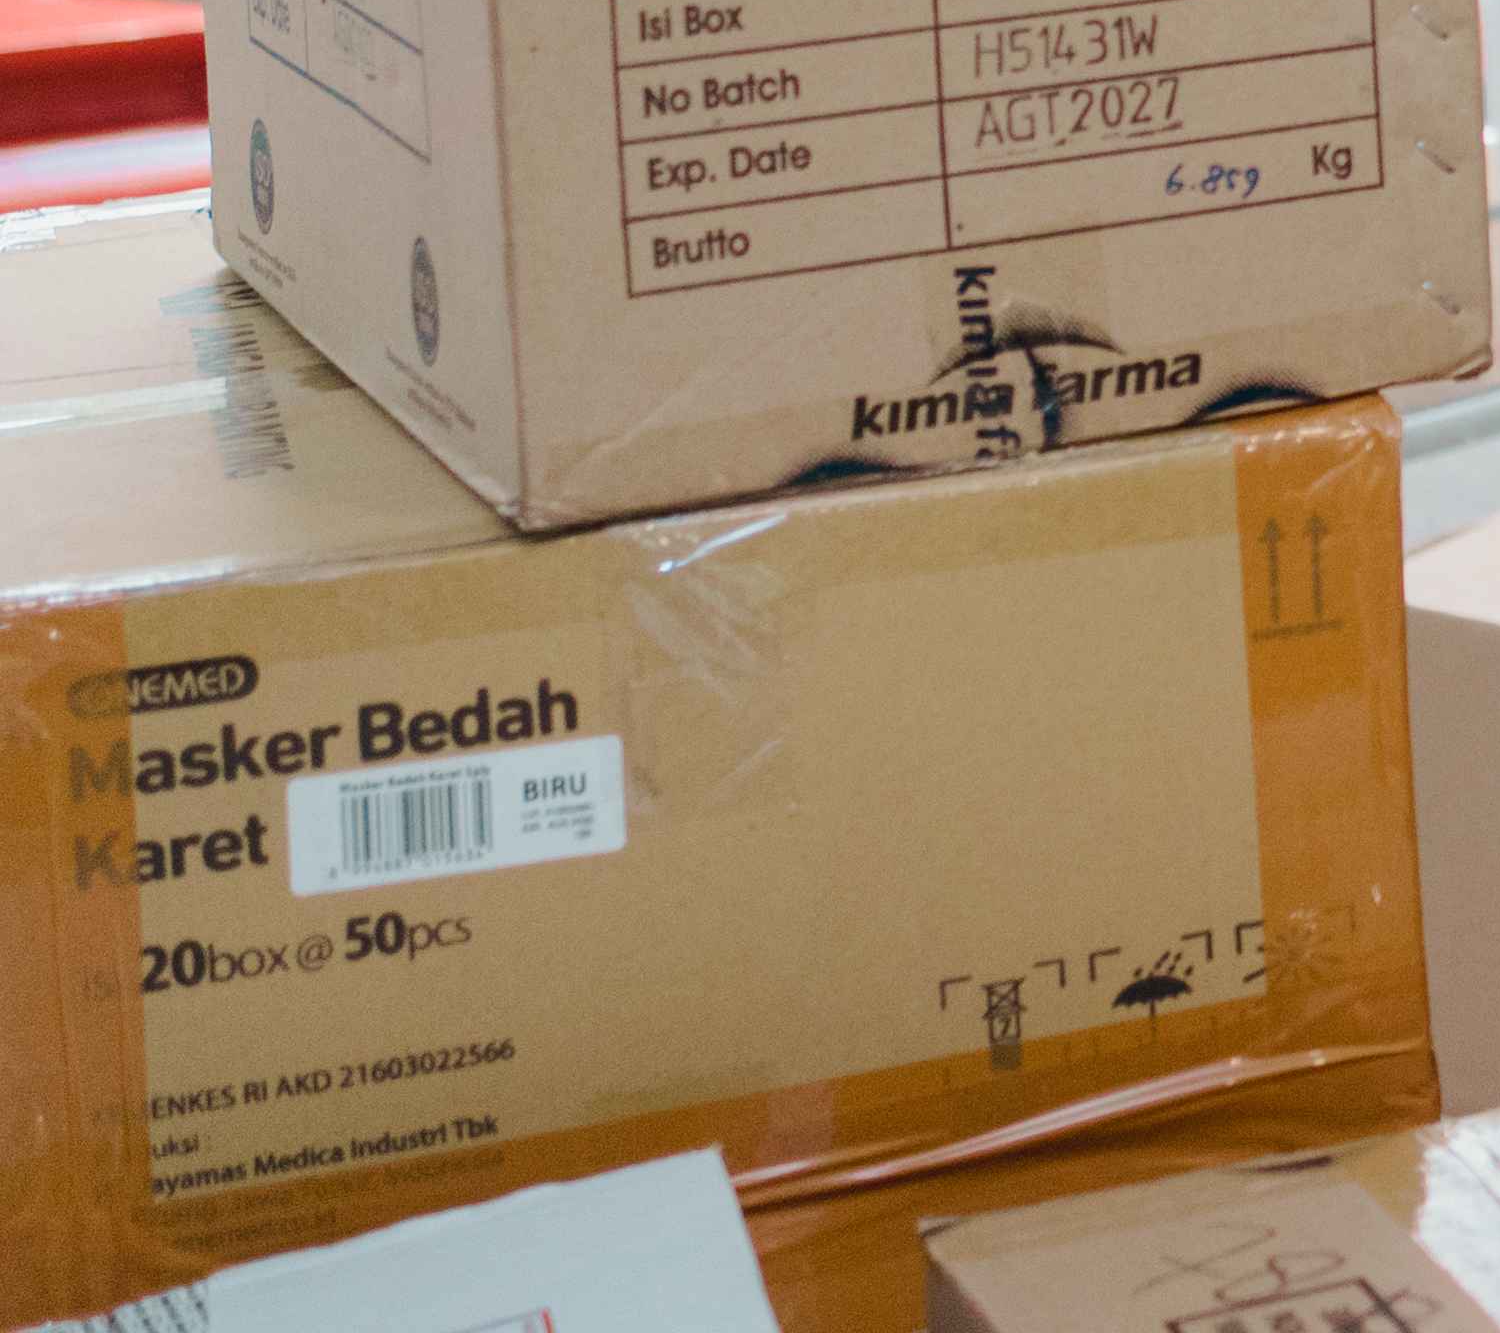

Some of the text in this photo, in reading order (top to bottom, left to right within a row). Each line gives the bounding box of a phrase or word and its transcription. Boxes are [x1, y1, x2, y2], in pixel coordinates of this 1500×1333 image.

[638, 4, 744, 42] Isi Box
[643, 69, 801, 119] No Batch
[647, 141, 812, 193] Exp. Date
[1311, 143, 1353, 179] Kg
[652, 228, 751, 270] Brutto
[69, 677, 579, 800] Masker Bedah
[522, 773, 588, 802] BIRU
[74, 813, 270, 889] Karet
[297, 934, 334, 972] @
[343, 910, 473, 962] 50pcs
[150, 1085, 236, 1120] ENKES
[243, 1078, 268, 1103] RI
[276, 1069, 332, 1099] AKD
[150, 1113, 499, 1197] ayamas Medica Industri Tbk
